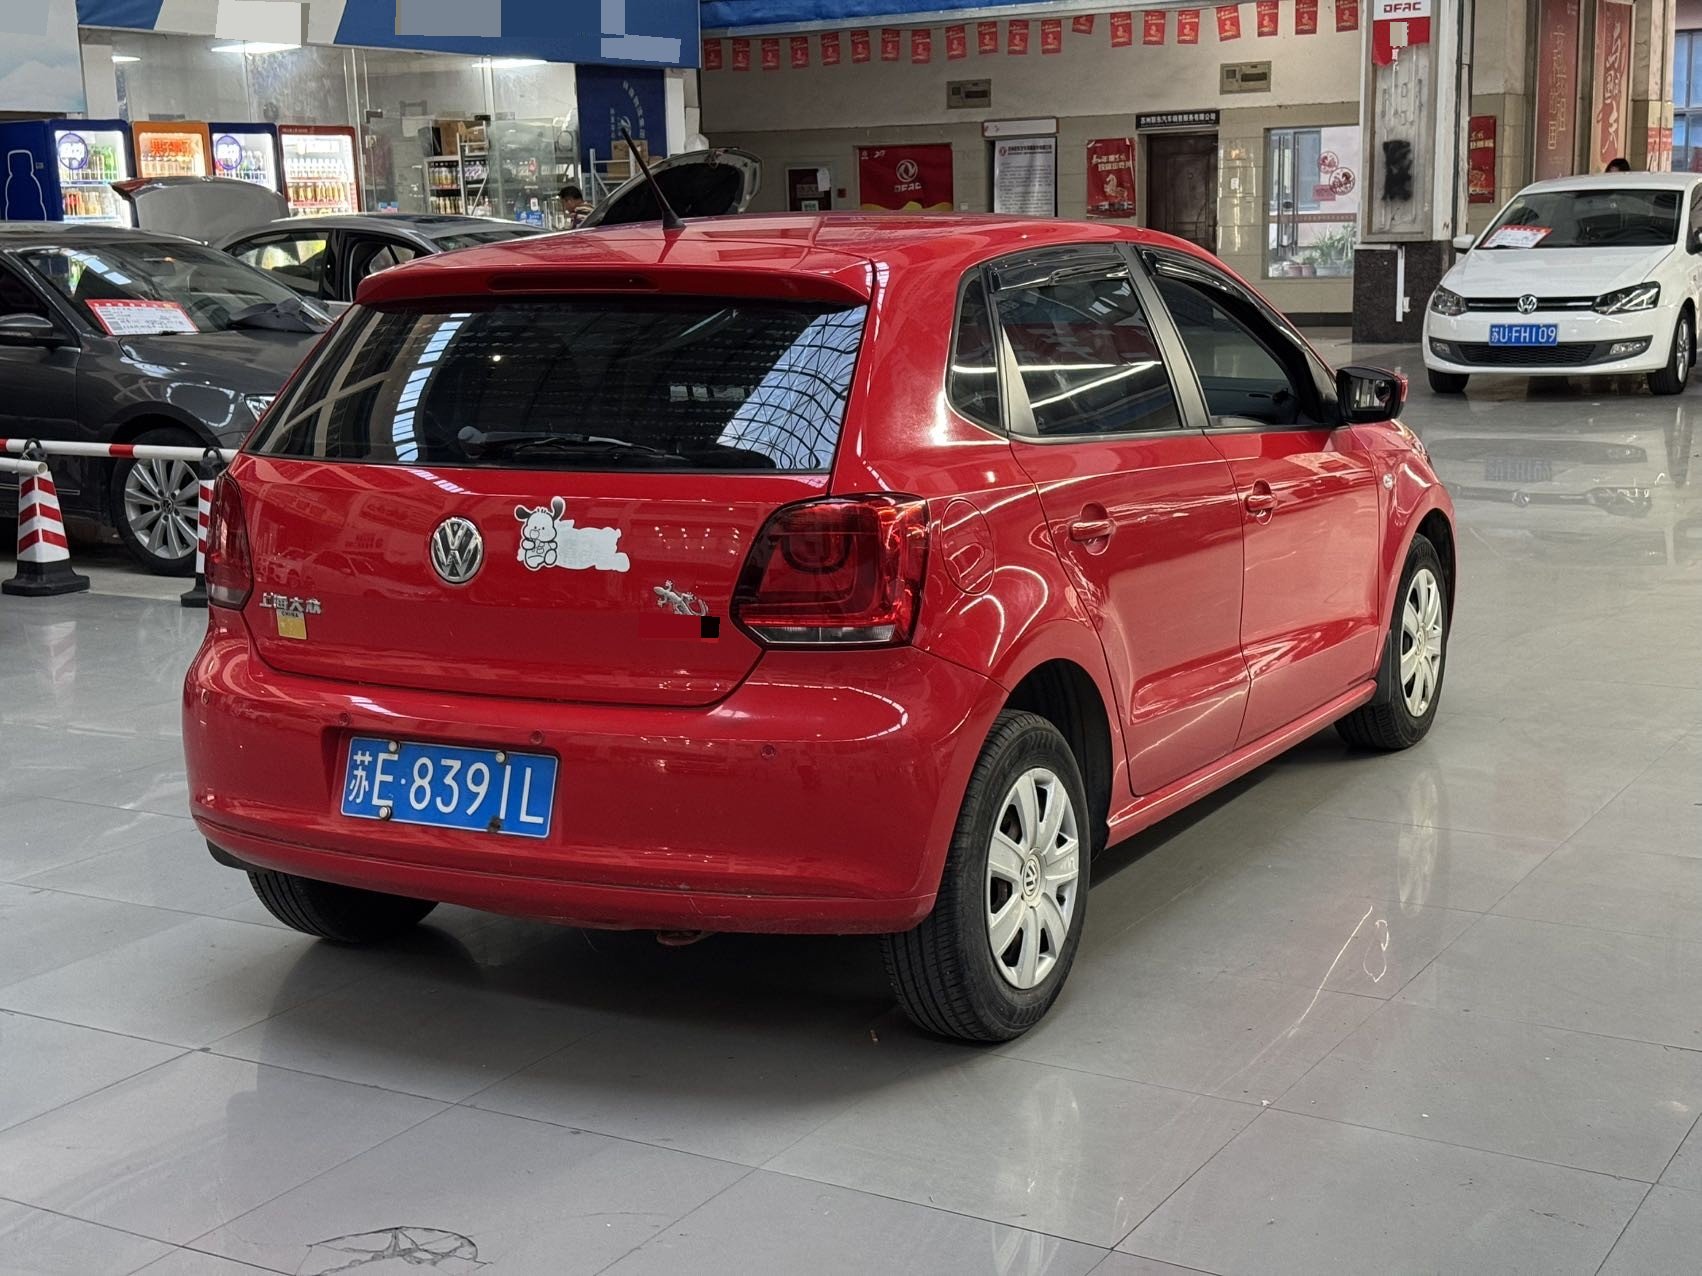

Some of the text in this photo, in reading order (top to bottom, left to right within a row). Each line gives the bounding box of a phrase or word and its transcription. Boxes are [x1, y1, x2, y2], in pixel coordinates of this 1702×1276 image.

[1384, 2, 1422, 13] DFAC
[259, 592, 322, 614] 上海大众
